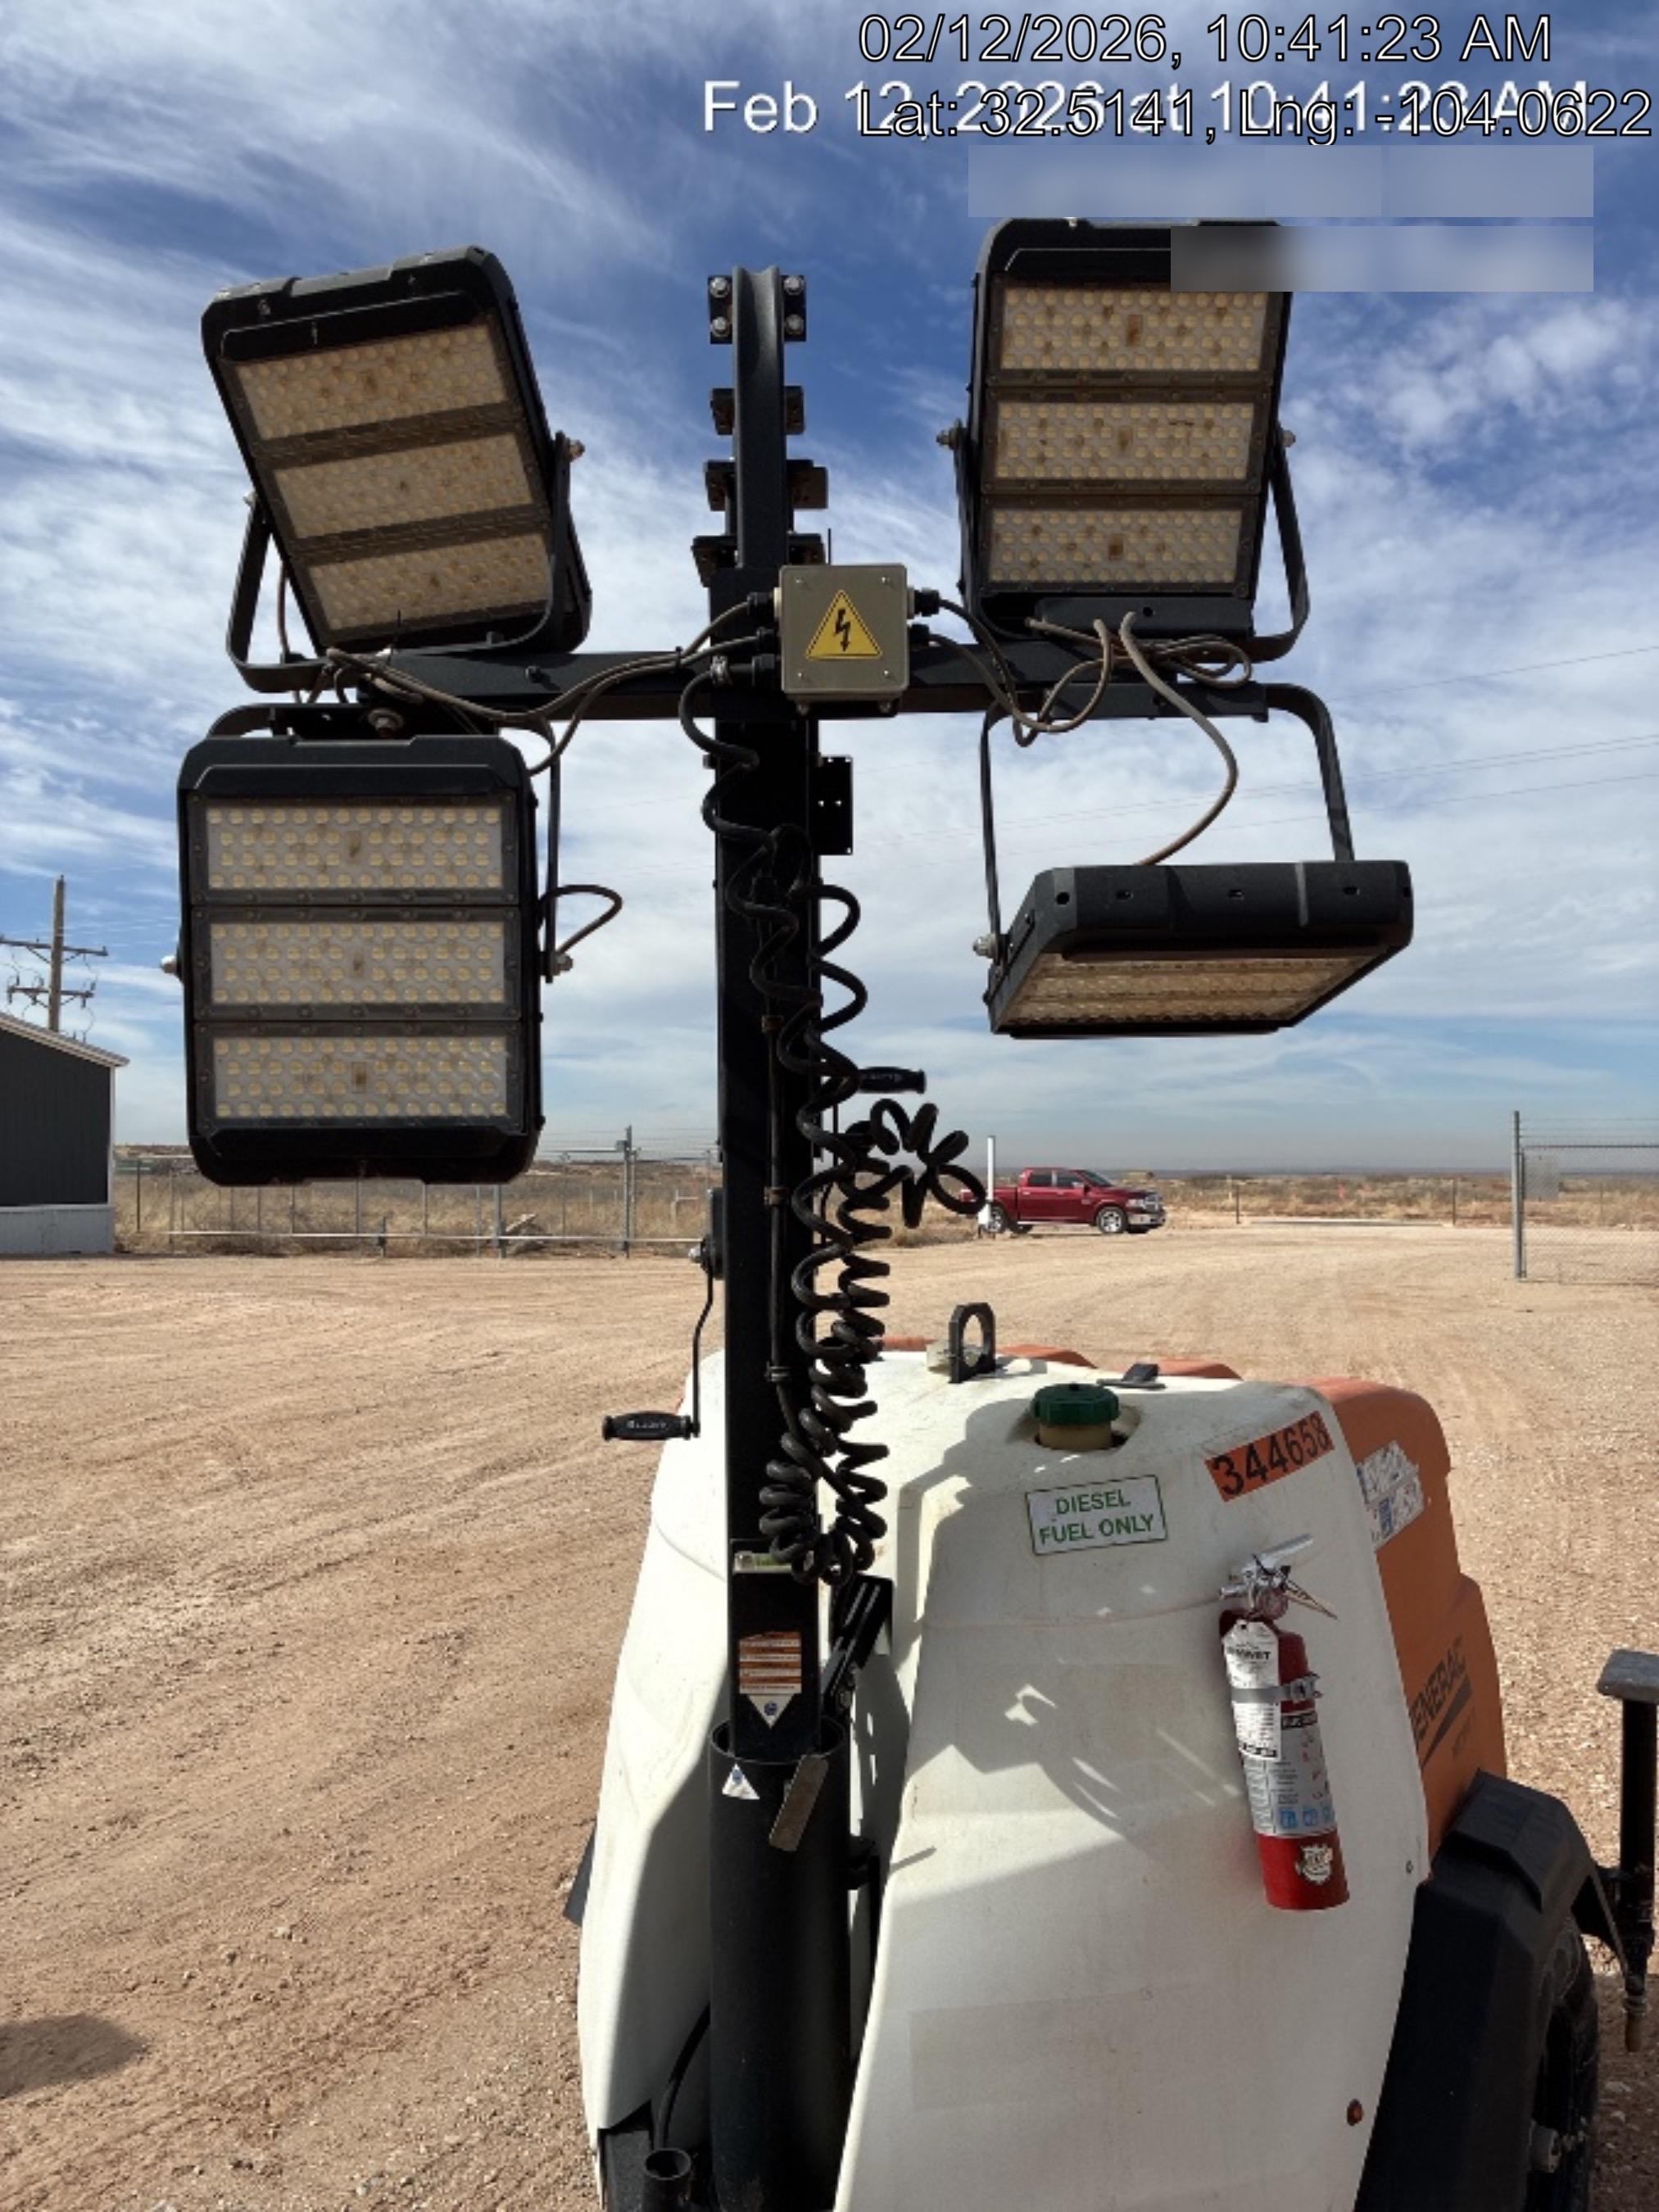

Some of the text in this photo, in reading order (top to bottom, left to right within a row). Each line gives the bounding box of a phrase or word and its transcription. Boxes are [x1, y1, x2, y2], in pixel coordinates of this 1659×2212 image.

[1212, 1411, 1334, 1494] 344658
[1055, 1489, 1131, 1515] DIESEL
[1039, 1514, 1154, 1546] FUEL ONLY
